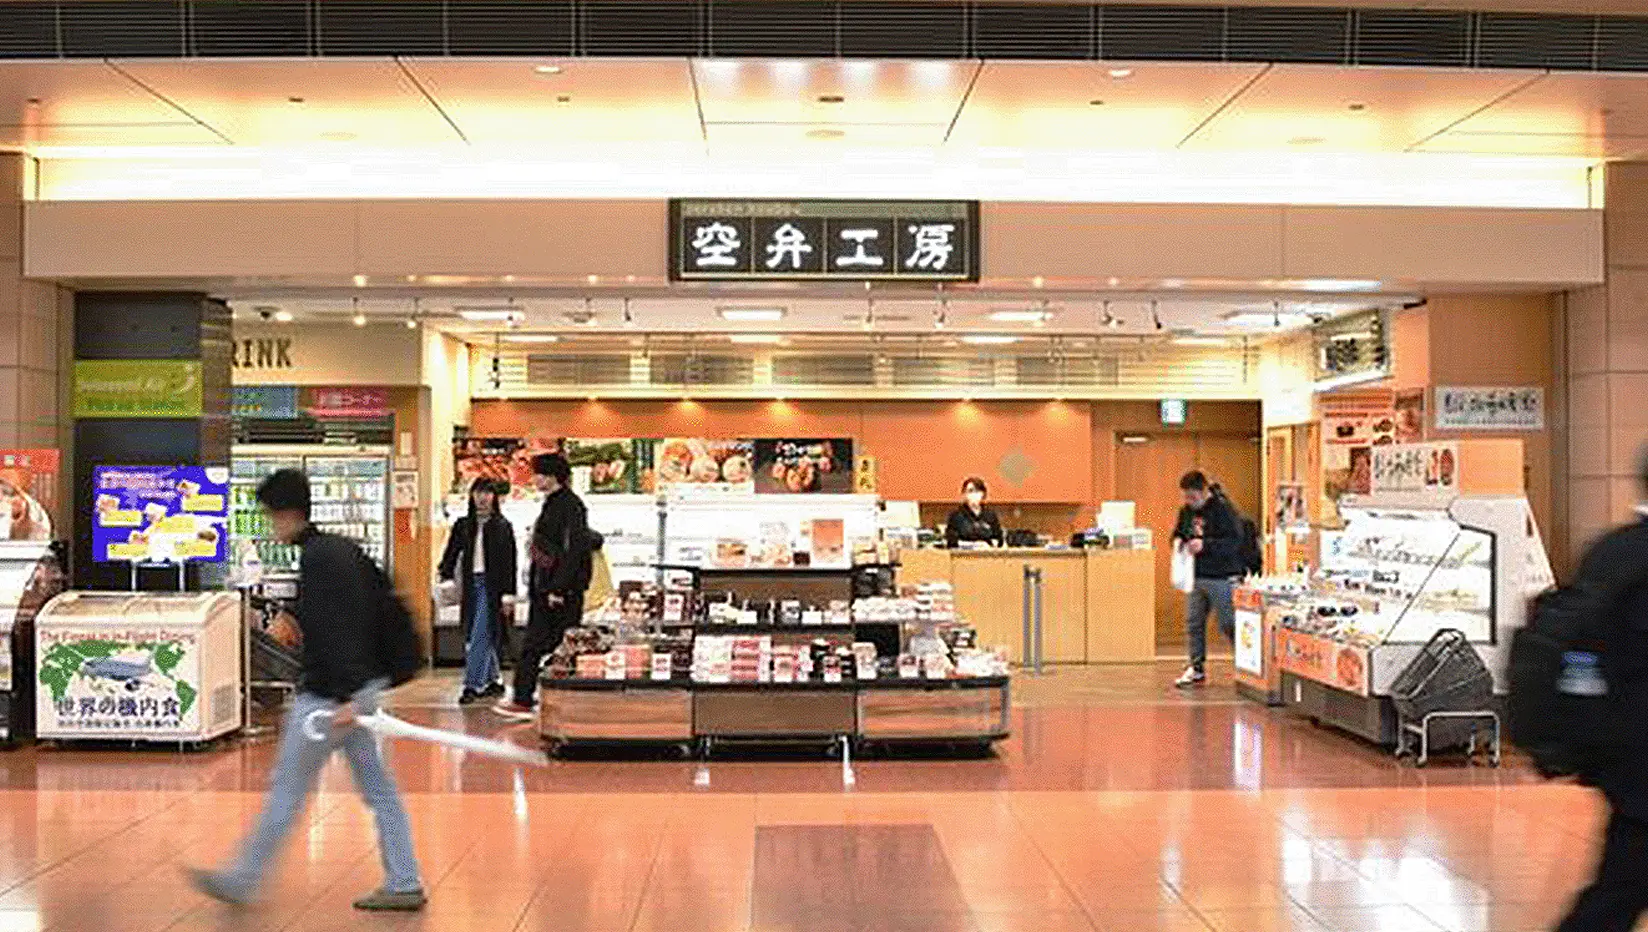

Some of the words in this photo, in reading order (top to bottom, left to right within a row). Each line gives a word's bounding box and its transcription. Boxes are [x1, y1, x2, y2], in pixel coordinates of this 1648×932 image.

[691, 222, 955, 270] 空弁工房
[57, 696, 179, 717] 世界の機内食
